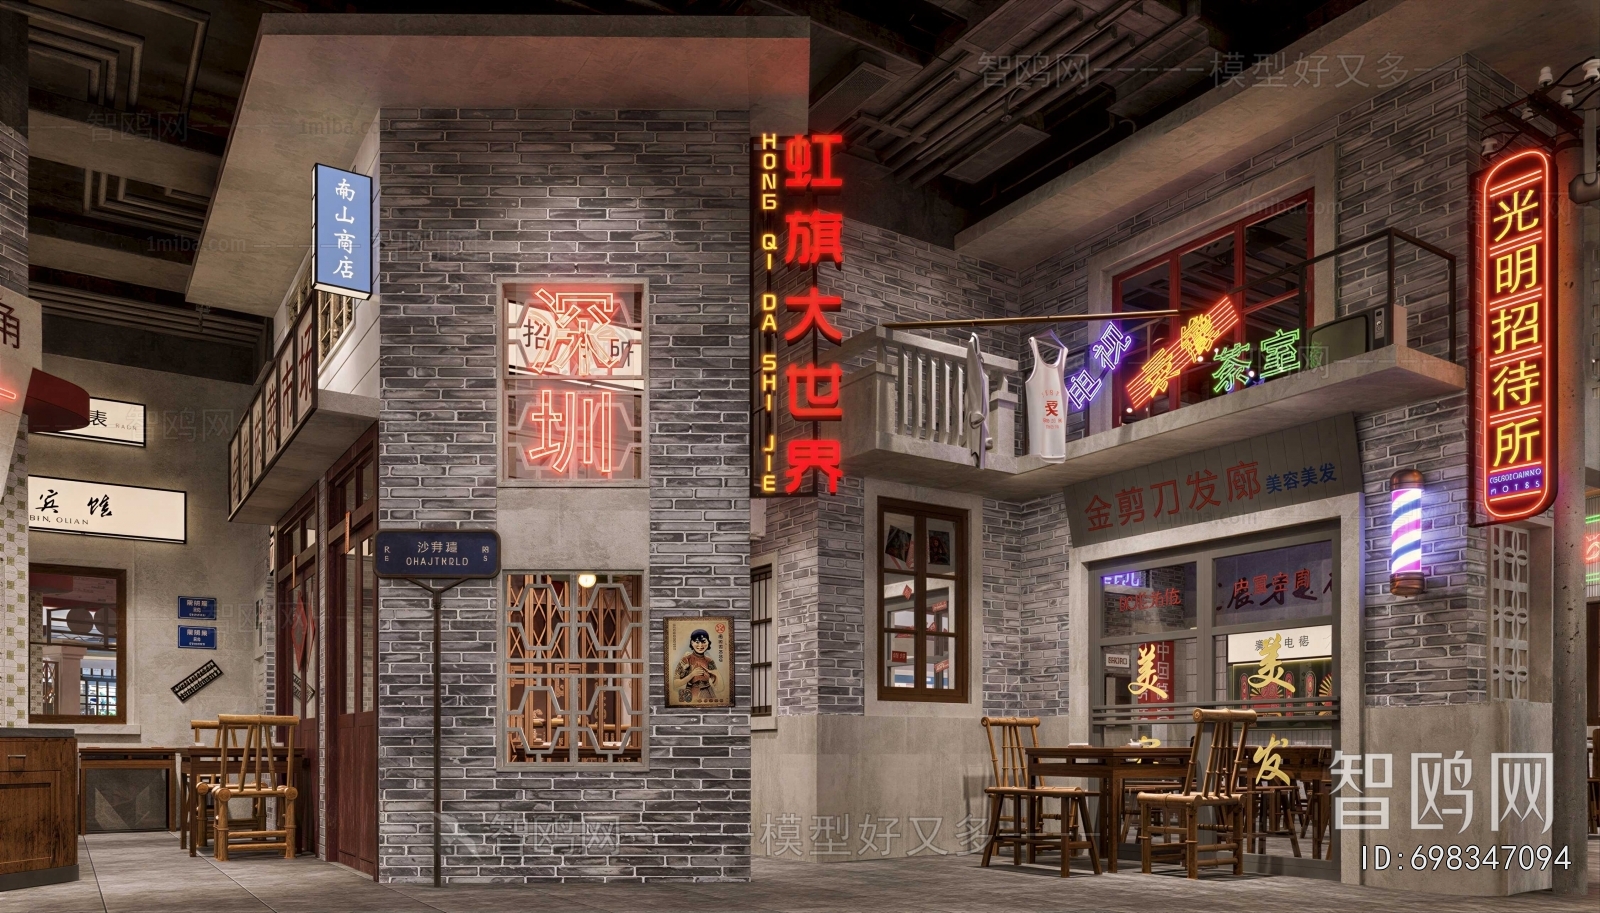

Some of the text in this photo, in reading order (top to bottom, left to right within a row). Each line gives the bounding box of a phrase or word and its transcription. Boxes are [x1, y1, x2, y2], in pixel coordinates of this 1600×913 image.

[333, 178, 356, 279] 南山商店
[762, 133, 777, 492] HONG QI DA SHI JIE
[785, 133, 843, 494] 虹旗大世界
[1491, 189, 1540, 468] 光明招待所
[1211, 328, 1300, 394] 茶室
[1084, 460, 1262, 532] 金剪刀发廊
[1265, 462, 1338, 495] 美容美发
[1127, 643, 1169, 699] 美
[1247, 632, 1296, 694] 美
